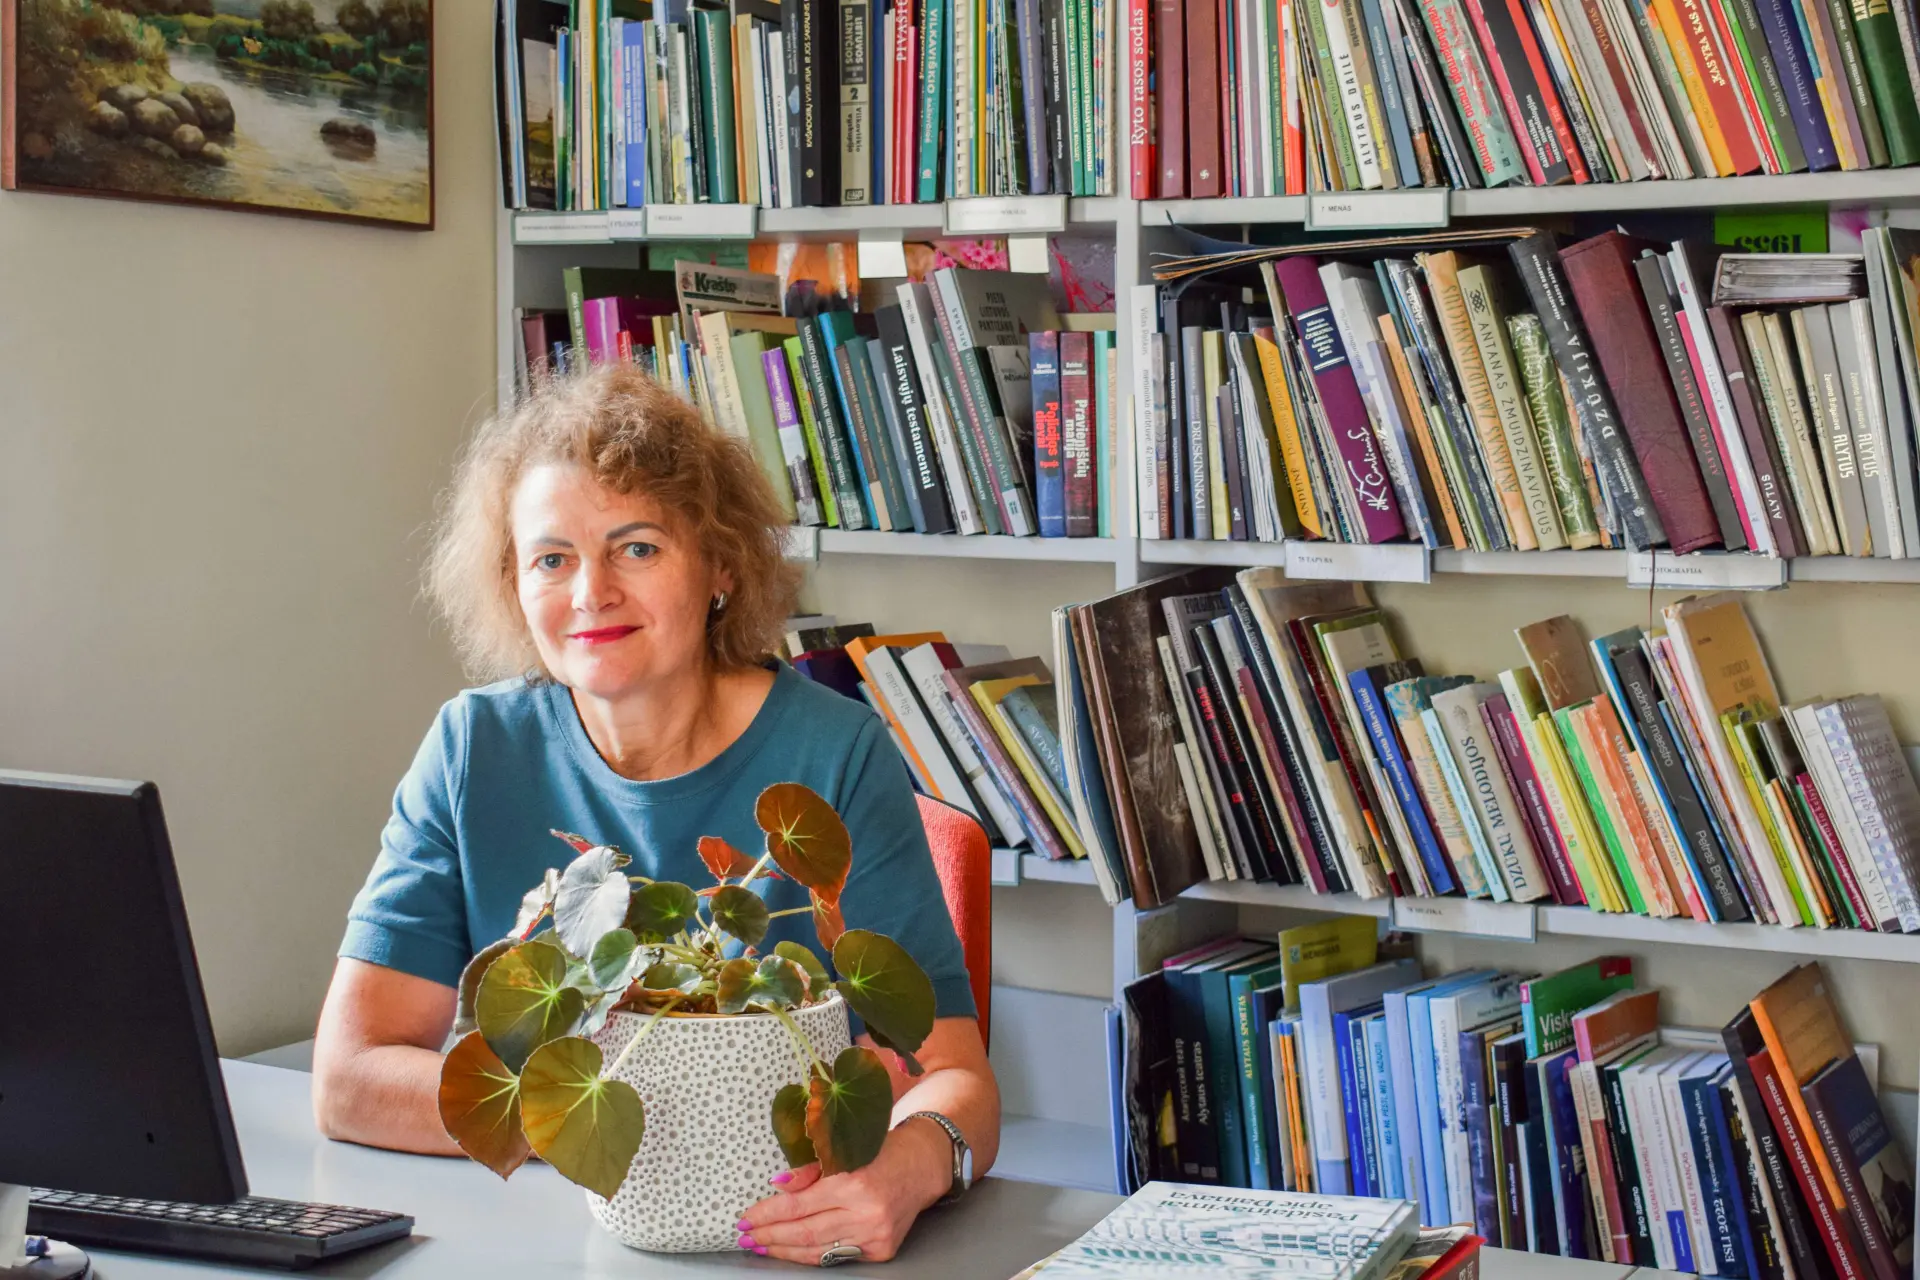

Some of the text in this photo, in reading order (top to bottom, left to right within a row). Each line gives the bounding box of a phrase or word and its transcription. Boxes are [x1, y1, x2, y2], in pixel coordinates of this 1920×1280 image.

[855, 16, 864, 64] LIETUVOS
[1587, 5, 1611, 51] VYTAUTAS
[1686, 11, 1704, 35] KAS
[1696, 35, 1714, 60] YRA
[926, 8, 938, 94] VILKAVIŠKIO
[1130, 8, 1148, 146] Ryto rasos sodas
[1423, 4, 1465, 86] vaizduojamojo
[1455, 85, 1476, 119] meno
[1466, 118, 1498, 175] sistemoje
[1789, 60, 1811, 106] LIETUVOS
[1337, 52, 1373, 166] ALYTAUS DAILĖ
[1523, 92, 1549, 144] metodologijos
[1526, 118, 1550, 169] dailės kritikos
[1543, 124, 1562, 163] metmenys
[1562, 332, 1617, 441] DZŪKIJA
[887, 343, 917, 405] Laisvųjų
[903, 405, 935, 490] testamentai
[1034, 411, 1045, 449] dievai
[1045, 402, 1059, 455] Policijos
[1064, 419, 1076, 459] mafija
[1074, 399, 1089, 479] Pravieniškių
[1477, 320, 1554, 535] ANTANAS ŽMUIDZINAVIČIUS
[1678, 368, 1720, 476] ALYTAUS ALBUMAS
[1190, 419, 1206, 509] DRUSKININKAI
[1483, 424, 1520, 496] ANTANAS
[1832, 432, 1855, 479] ALYTUS
[1856, 431, 1880, 478] ALYTUS
[1759, 472, 1782, 521] ALYTUS
[1027, 724, 1061, 774] SAKALAS
[1377, 737, 1394, 762] Irena
[1647, 722, 1676, 768] maestro
[1459, 733, 1509, 830] MELODIJOS
[1494, 832, 1529, 890] DZŪKŲ
[1692, 828, 1737, 906] Petras Bingelis
[1174, 1037, 1186, 1065] театр
[1236, 994, 1253, 1079] ALYTAUS SPORTAS
[1191, 1040, 1211, 1125] Alytaus teatras
[1761, 1134, 1786, 1190] Dla Miłosza
[1156, 1197, 1358, 1224] Pasidainavimai
[1276, 1198, 1333, 1211] apie
[1630, 1185, 1648, 1237] Parlo italiano
[1689, 1191, 1700, 1216] PARLE
[1712, 1196, 1729, 1234] 2022
[1720, 1234, 1735, 1263] ESLI
[1833, 1239, 1854, 1276] DZŪKIJOS
